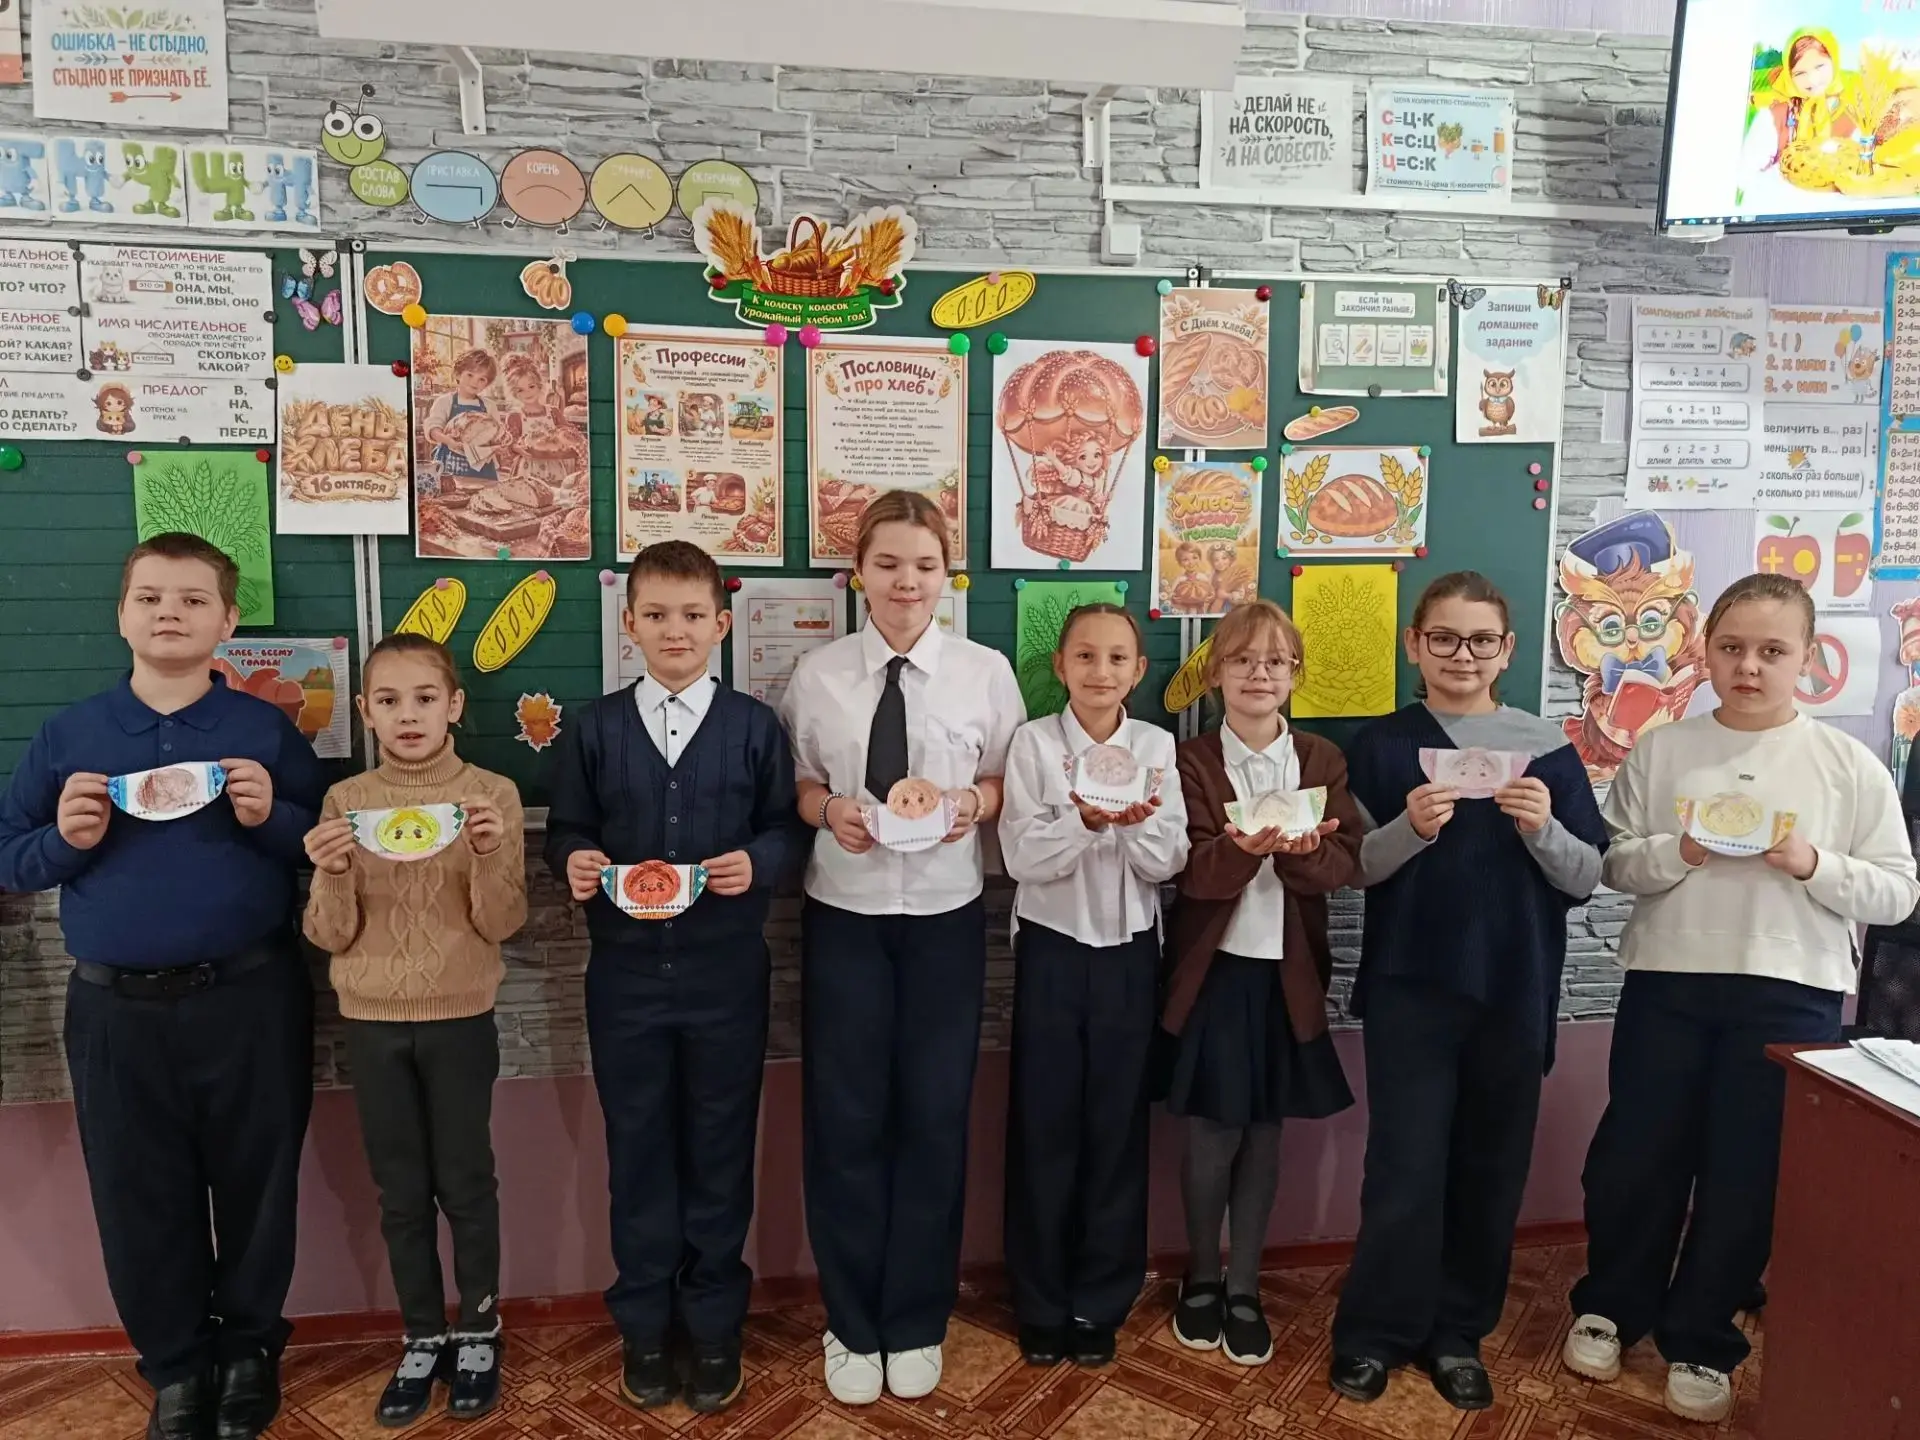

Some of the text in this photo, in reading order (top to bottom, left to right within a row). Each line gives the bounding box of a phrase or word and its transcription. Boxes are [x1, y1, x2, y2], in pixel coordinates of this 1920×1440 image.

[52, 32, 208, 55] ОШИБКА НЕ СТЫДНО,
[53, 66, 211, 88] СТЫДНО НЕ ПРИЗНАТЬ ЕЁ.
[1243, 93, 1315, 114] ДЕЛАЙ НЕ
[1230, 116, 1333, 139] НА СКОРОСТЬ,
[1226, 141, 1332, 166] А НА СОВЕСТЬ.
[358, 166, 400, 184] СОСТАВ
[427, 165, 480, 178] ПРИСТАВКА
[526, 162, 560, 176] КОРЕНЬ
[362, 182, 396, 198] СЛОВА
[118, 249, 226, 263] МЕСТОИМЕНИЕ
[29, 282, 66, 294] ЧТО?
[176, 284, 234, 295] ОНА, МЫ,
[232, 298, 258, 306] ОНО
[752, 295, 848, 312] К колоску колосок
[1488, 301, 1531, 312] Запиши
[0, 312, 60, 324] ЕЛЬНОЕ
[744, 307, 868, 324] урожайный хлебом год!
[1705, 306, 1753, 320] действий
[98, 318, 246, 333] ИМЯ ЧИСЛИТЕЛЬНОЕ
[1180, 316, 1256, 340] С Днём хлеба!
[1478, 321, 1538, 332] домашнее
[1652, 330, 1708, 340] 6 2 8
[25, 340, 72, 350] КАКАЯ?
[1486, 338, 1532, 350] задание
[25, 353, 72, 362] КАКИЕ?
[198, 351, 266, 360] СКОЛЬКО?
[656, 348, 746, 368] Профессии
[199, 362, 250, 372] КАКОЙ?
[840, 360, 936, 380] Пословицы
[1670, 367, 1726, 377] 6 2 4
[143, 385, 208, 396] ПРЕДЛОГ
[855, 379, 926, 396] про хлеб
[229, 399, 252, 410] НА,
[1667, 405, 1720, 415] 6 2 12
[12, 410, 68, 420] ДЕЛАТЬ?
[298, 401, 398, 439] ДЕНЬ
[12, 422, 78, 432] СДЕЛАТЬ?
[220, 428, 268, 439] ПЕРЕД
[1842, 426, 1862, 437] раз
[282, 435, 407, 474] ХЛЕБА
[1664, 444, 1720, 454] 6 2 3
[1842, 446, 1861, 456] раз
[1766, 470, 1860, 482] сколько раз больше
[310, 476, 386, 494] 16 октября
[1766, 488, 1858, 500] сколько раз меньше
[1174, 494, 1234, 518] Хлеб
[752, 609, 762, 624] 4
[622, 645, 632, 660] 2
[752, 648, 762, 663] 5
